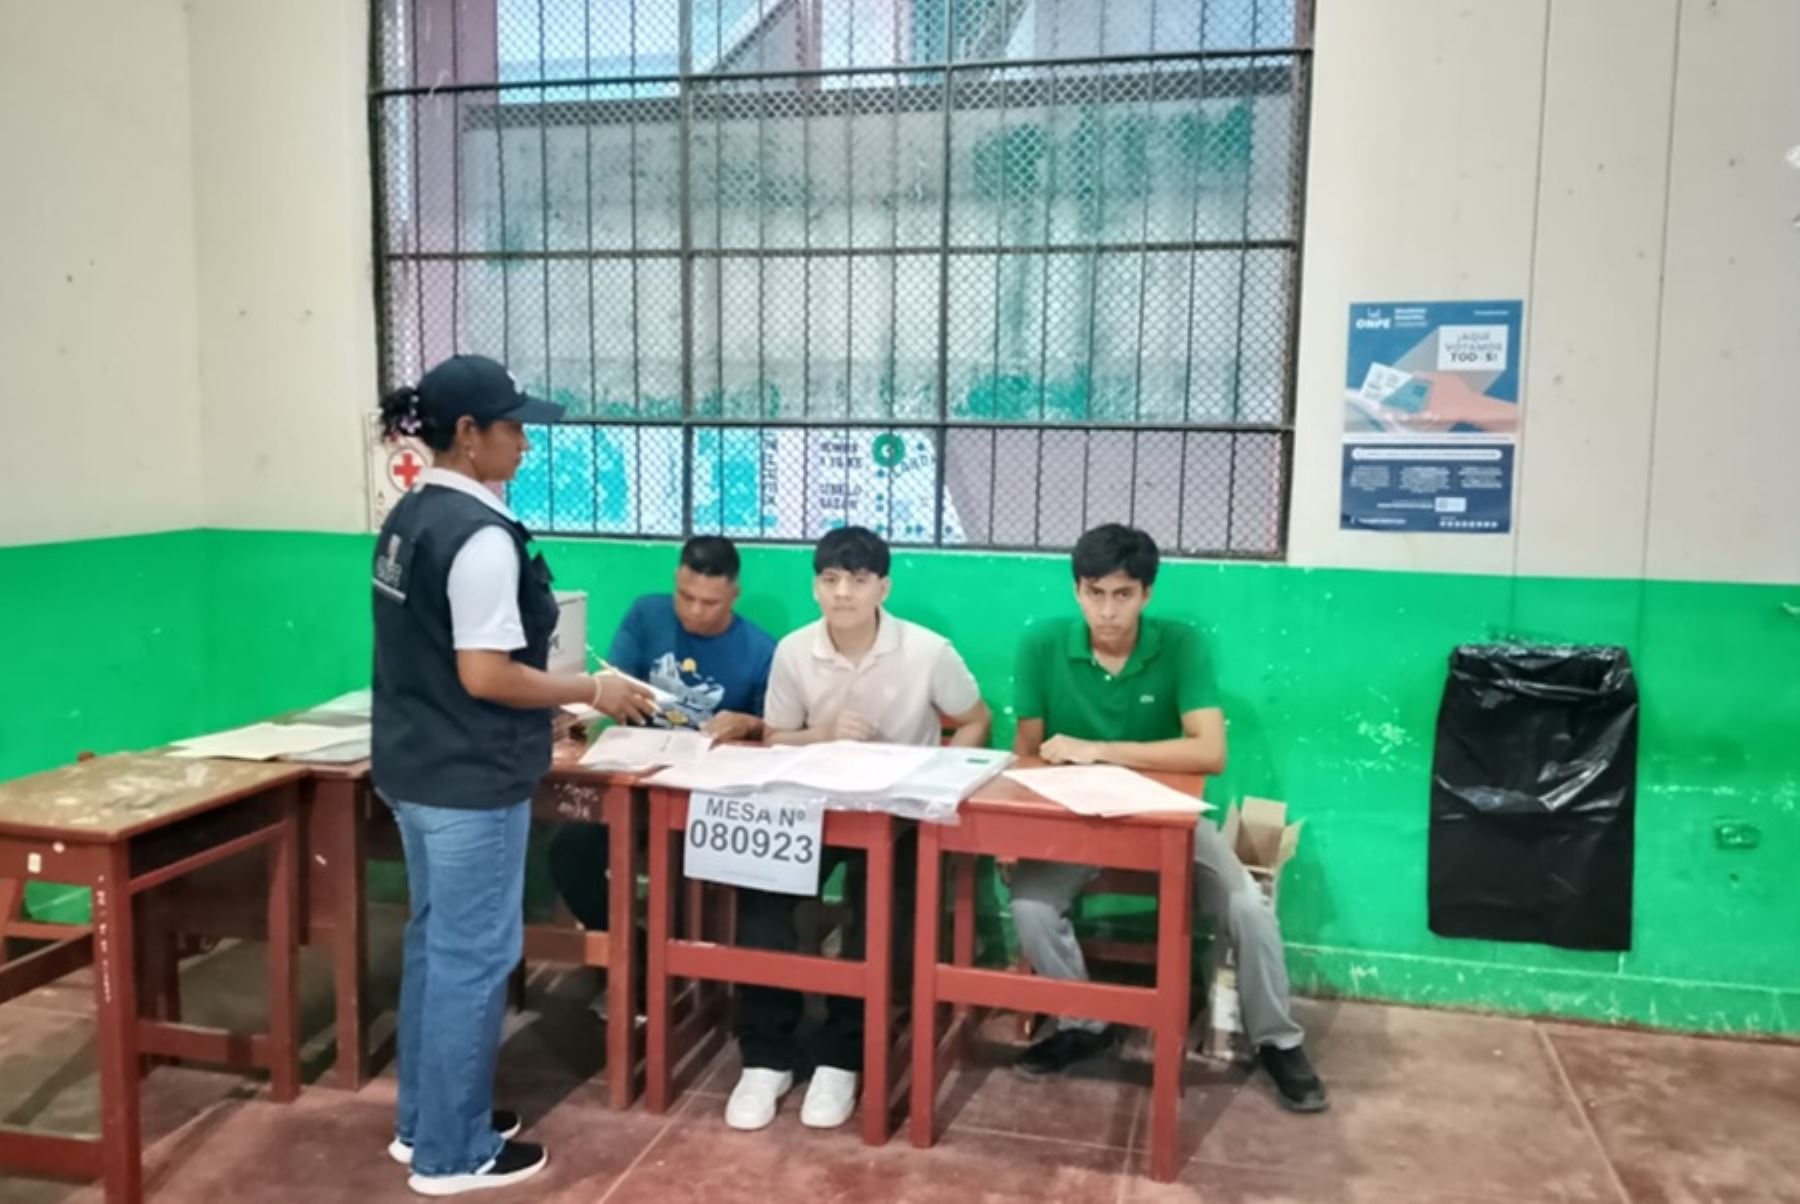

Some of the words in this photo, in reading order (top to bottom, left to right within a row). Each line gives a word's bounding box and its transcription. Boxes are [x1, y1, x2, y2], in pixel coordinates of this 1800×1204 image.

[1356, 319, 1391, 329] ONPE
[1445, 343, 1502, 352] VOTAMOS
[706, 797, 772, 825] MESA
[690, 819, 813, 864] 080923
